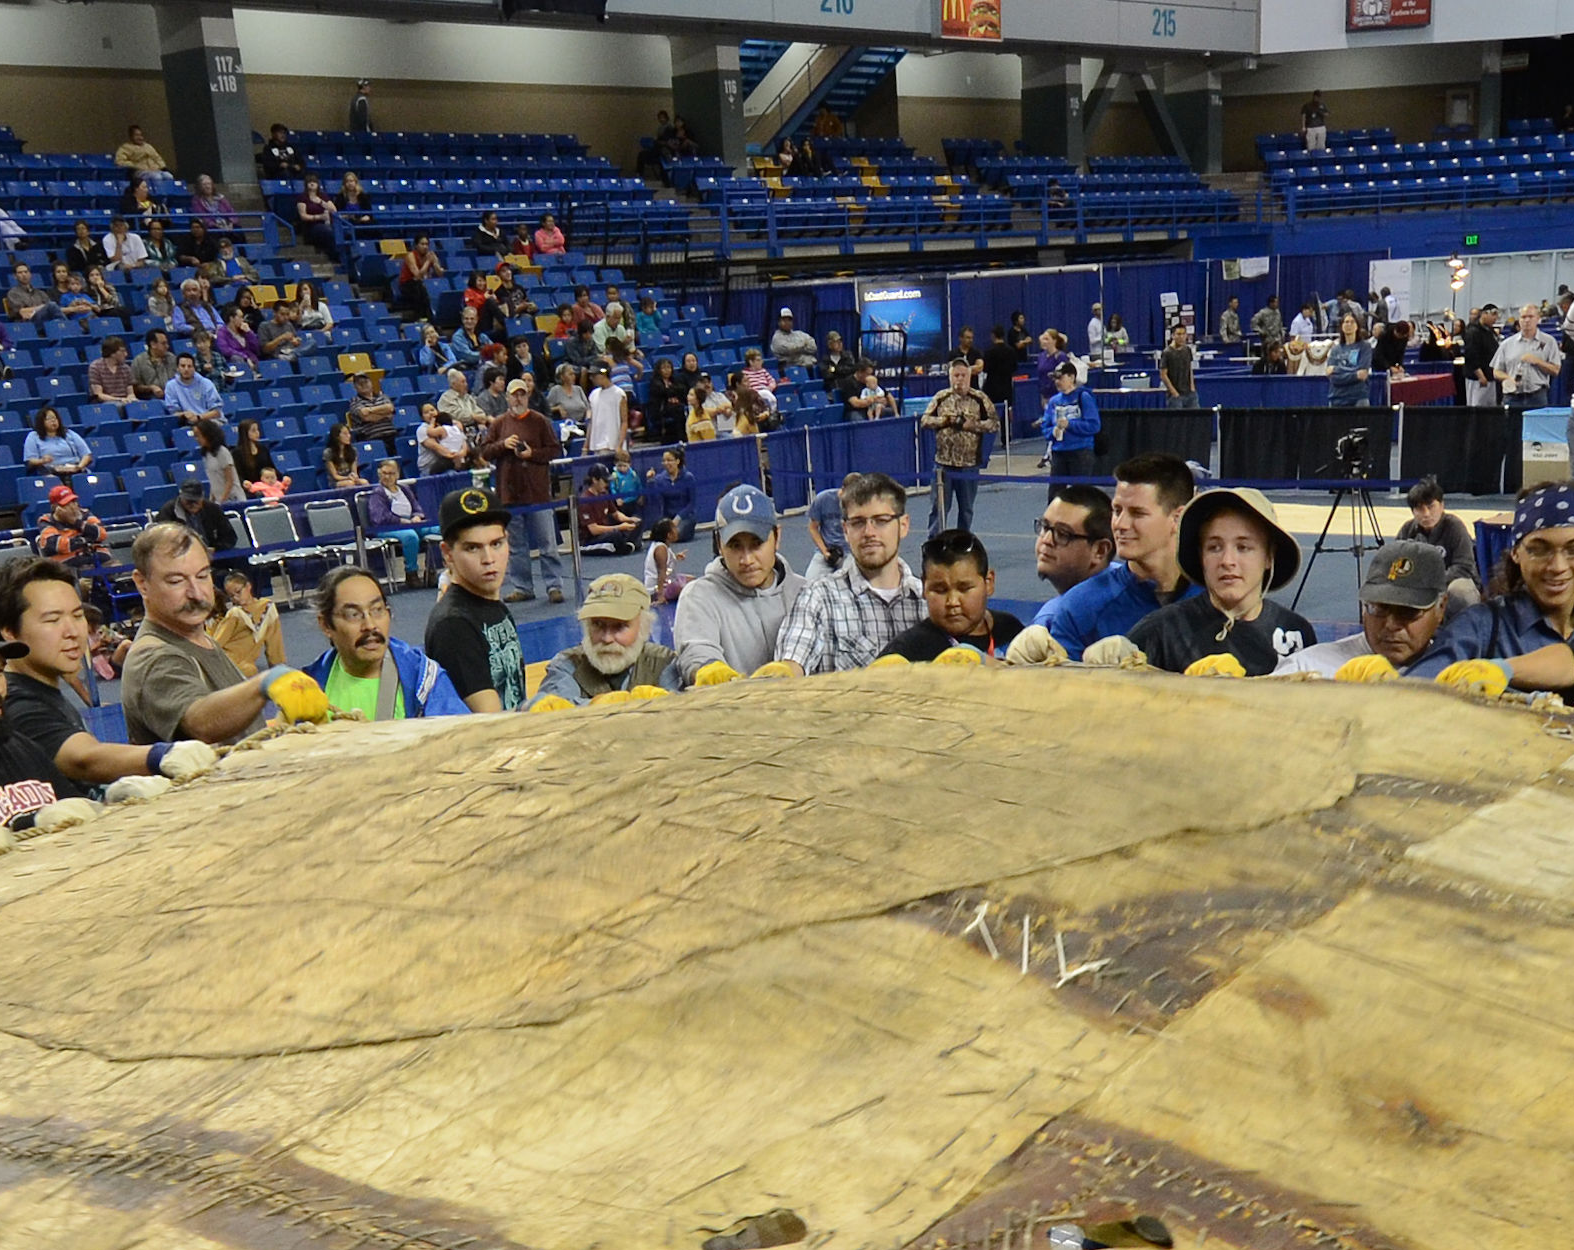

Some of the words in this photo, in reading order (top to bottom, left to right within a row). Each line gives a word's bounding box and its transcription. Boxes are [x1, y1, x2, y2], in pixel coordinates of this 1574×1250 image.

[1152, 8, 1176, 37] 215
[215, 55, 233, 73] 117
[217, 75, 237, 92] 118
